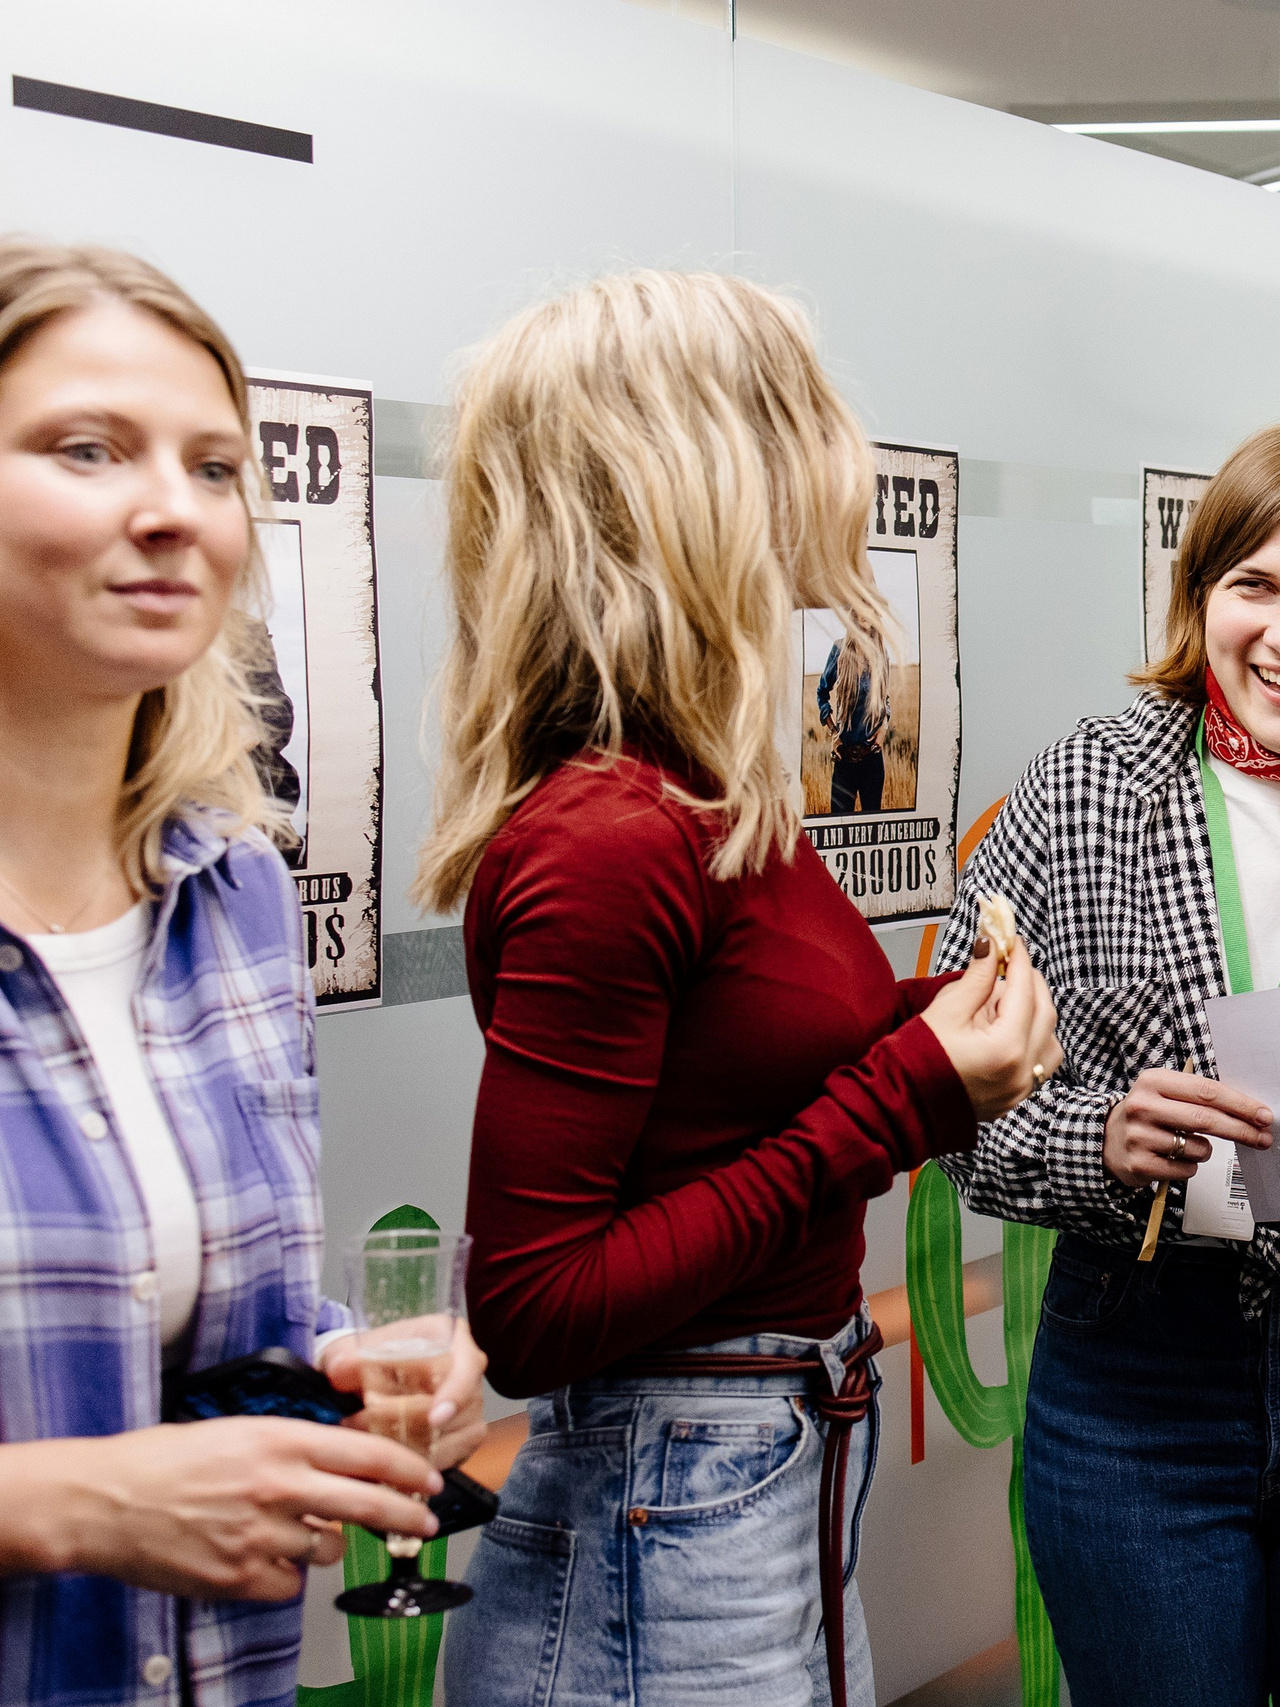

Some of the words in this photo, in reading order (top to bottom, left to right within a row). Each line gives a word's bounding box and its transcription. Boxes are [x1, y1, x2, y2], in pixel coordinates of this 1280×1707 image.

[875, 473, 941, 539] TED
[823, 827, 844, 847] AND
[848, 825, 873, 845] VERY
[877, 820, 934, 843] DANGEROUS
[835, 844, 937, 897] 20000$
